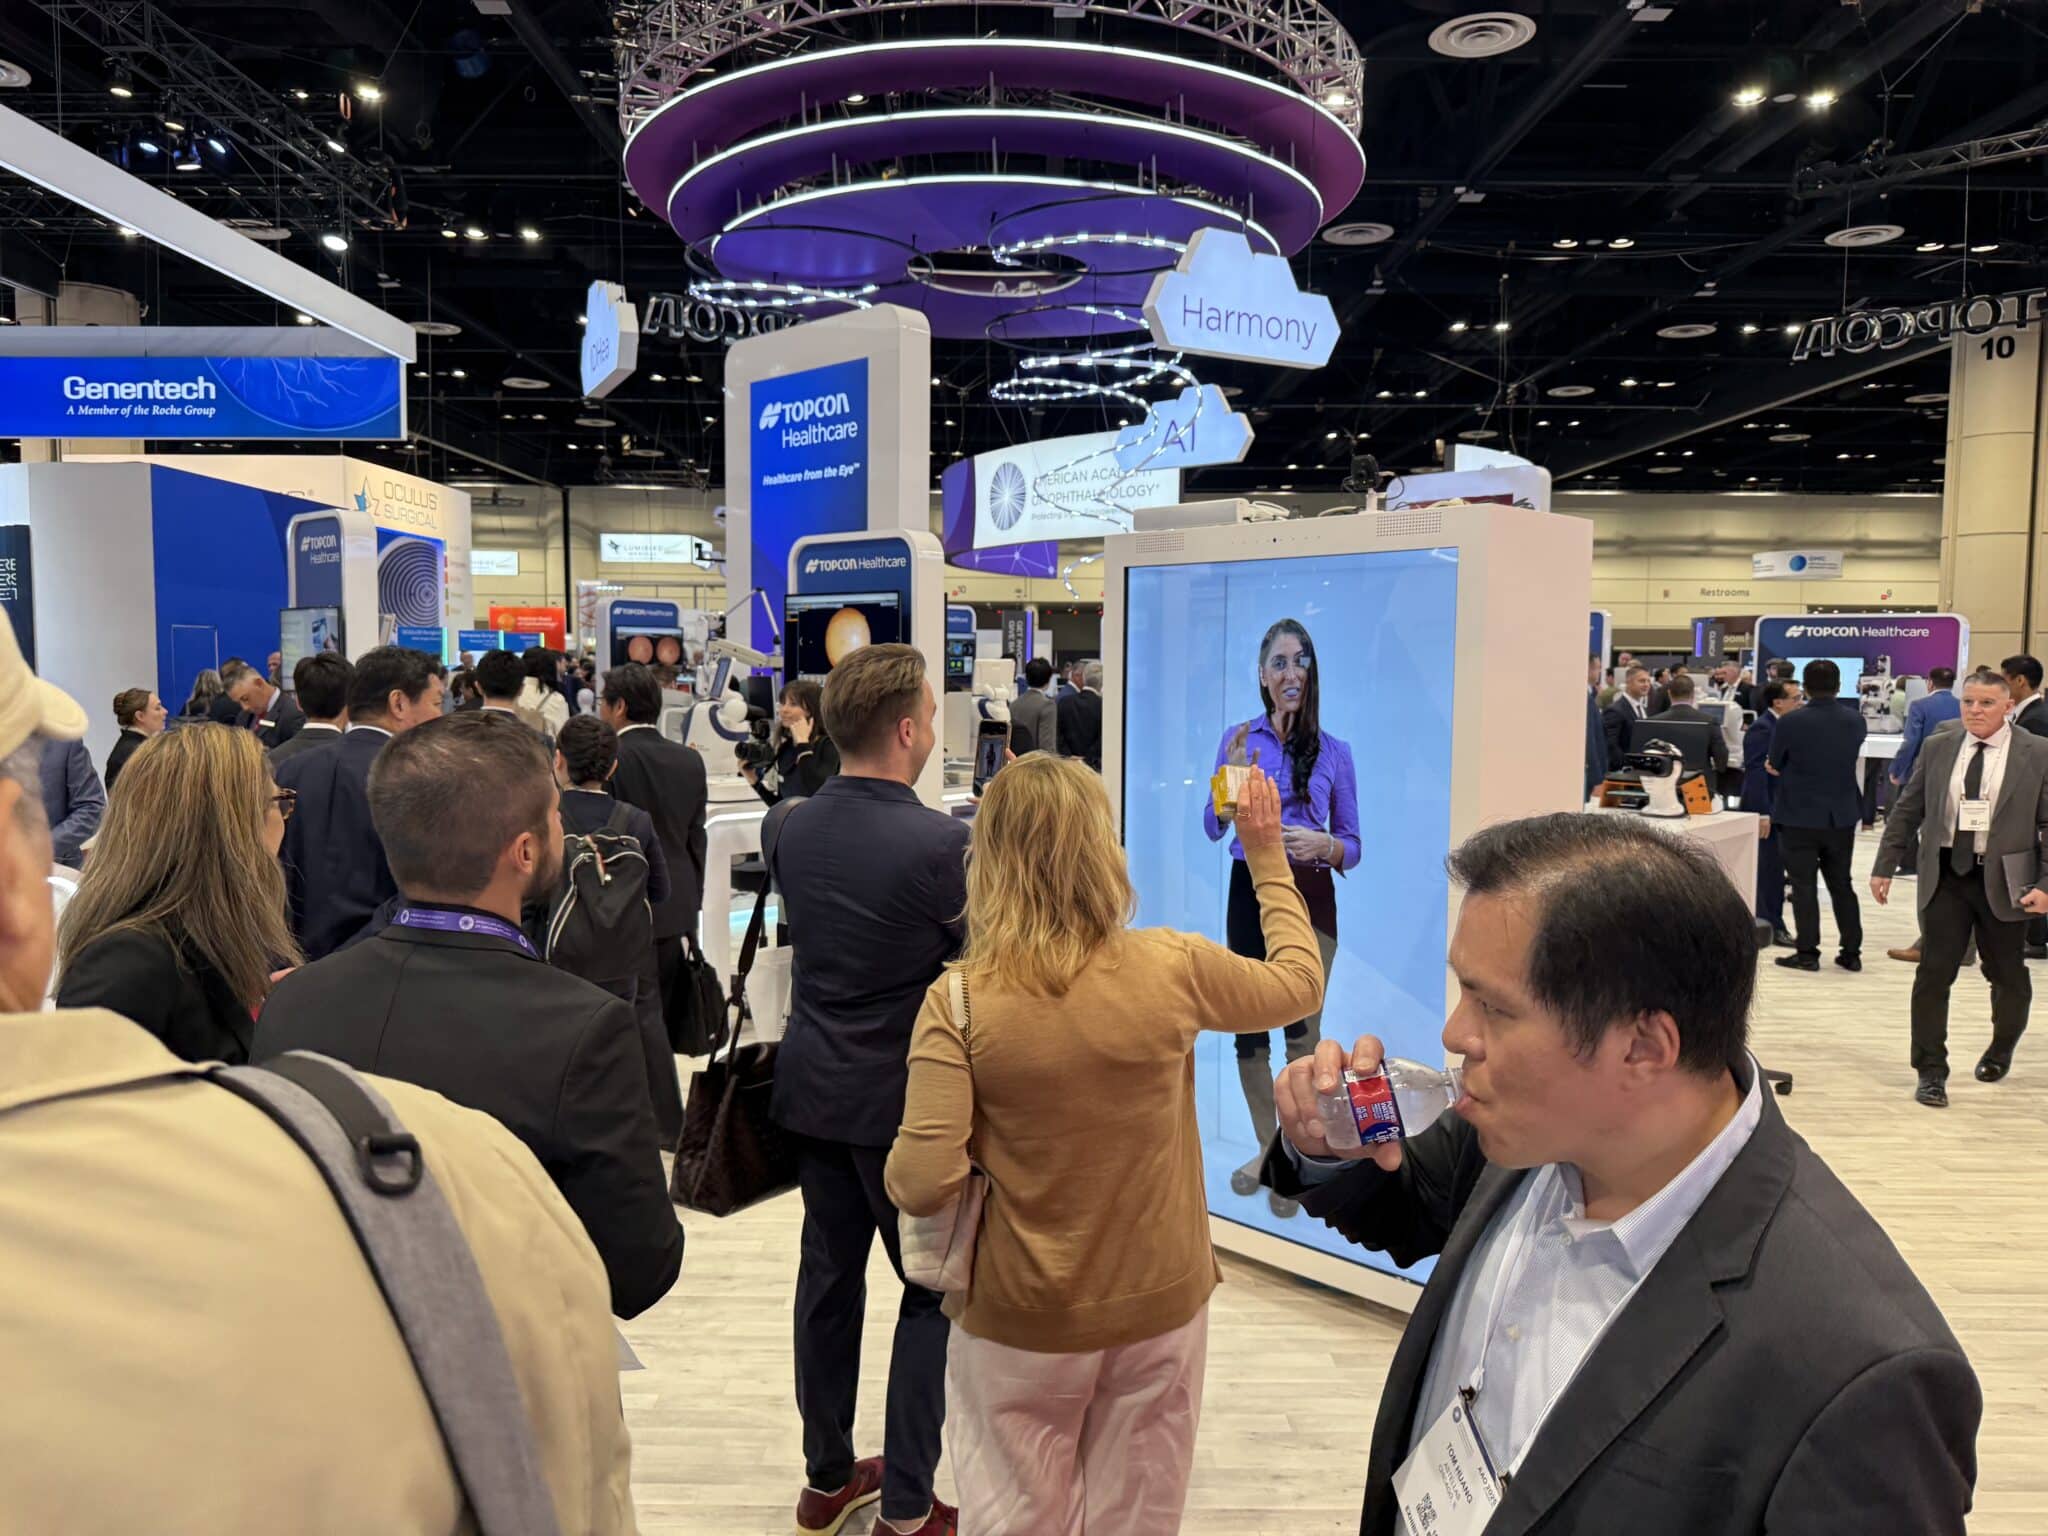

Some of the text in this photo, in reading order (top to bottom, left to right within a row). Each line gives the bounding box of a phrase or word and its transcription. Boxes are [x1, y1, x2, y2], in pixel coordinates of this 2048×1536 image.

[1183, 294, 1317, 351] Harmony
[1981, 335, 2016, 360] 10
[63, 375, 216, 400] Genentech
[66, 404, 216, 418] A Member of the Roche Group
[782, 393, 850, 424] TOPCON
[782, 421, 859, 448] Healthcare
[1161, 419, 1196, 452] AI
[762, 472, 803, 486] Healthcare
[803, 469, 823, 480] from
[824, 466, 838, 478] the
[384, 481, 438, 510] OCULUS
[384, 504, 438, 529] SURGICAL
[310, 535, 337, 550] TOPCON
[310, 551, 340, 564] Healthcare
[819, 556, 907, 573] TOPCON Healthcare
[1700, 587, 1750, 597] Restrooms
[1806, 626, 1930, 638] TOPCON Healthcare
[1446, 1442, 1458, 1466] TOM
[1455, 1465, 1473, 1504] HUANG
